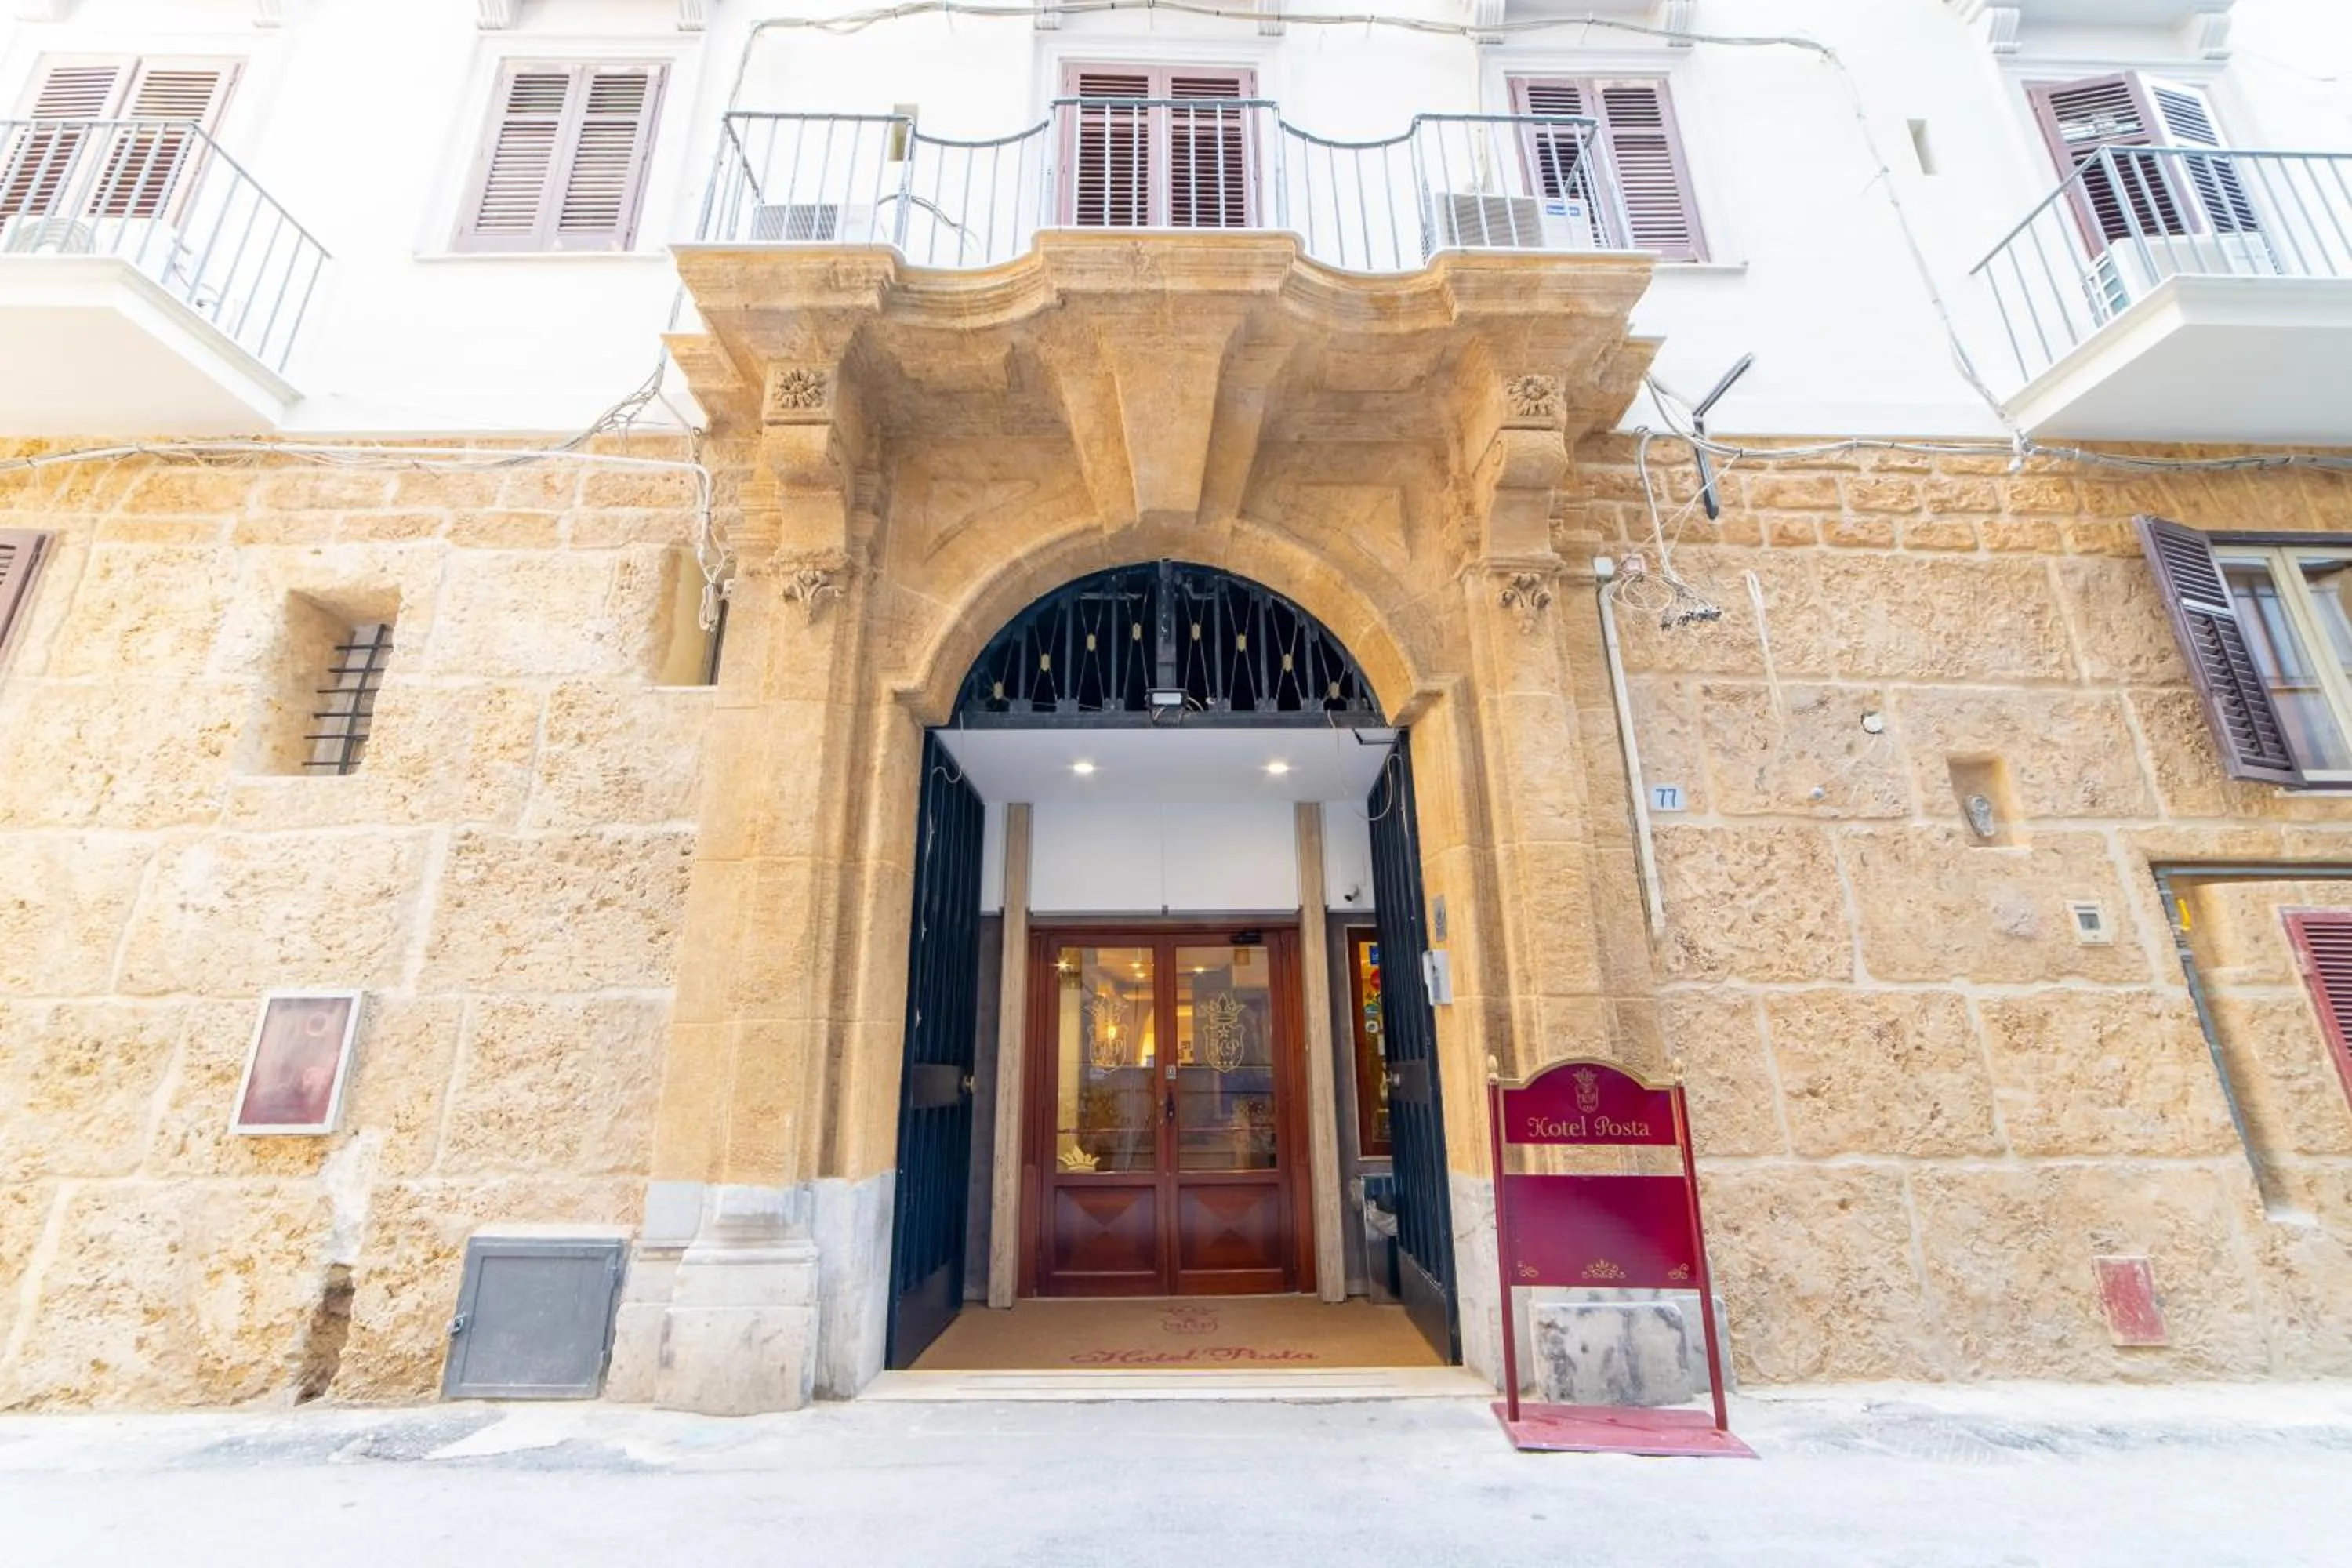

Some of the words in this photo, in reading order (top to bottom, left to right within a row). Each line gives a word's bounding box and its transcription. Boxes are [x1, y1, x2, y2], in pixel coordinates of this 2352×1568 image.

[1655, 788, 1677, 809] 77
[1528, 1116, 1587, 1138] Hotel
[1594, 1116, 1650, 1137] Posta
[1069, 1349, 1198, 1363] Hotel
[1203, 1347, 1319, 1361] Posta
